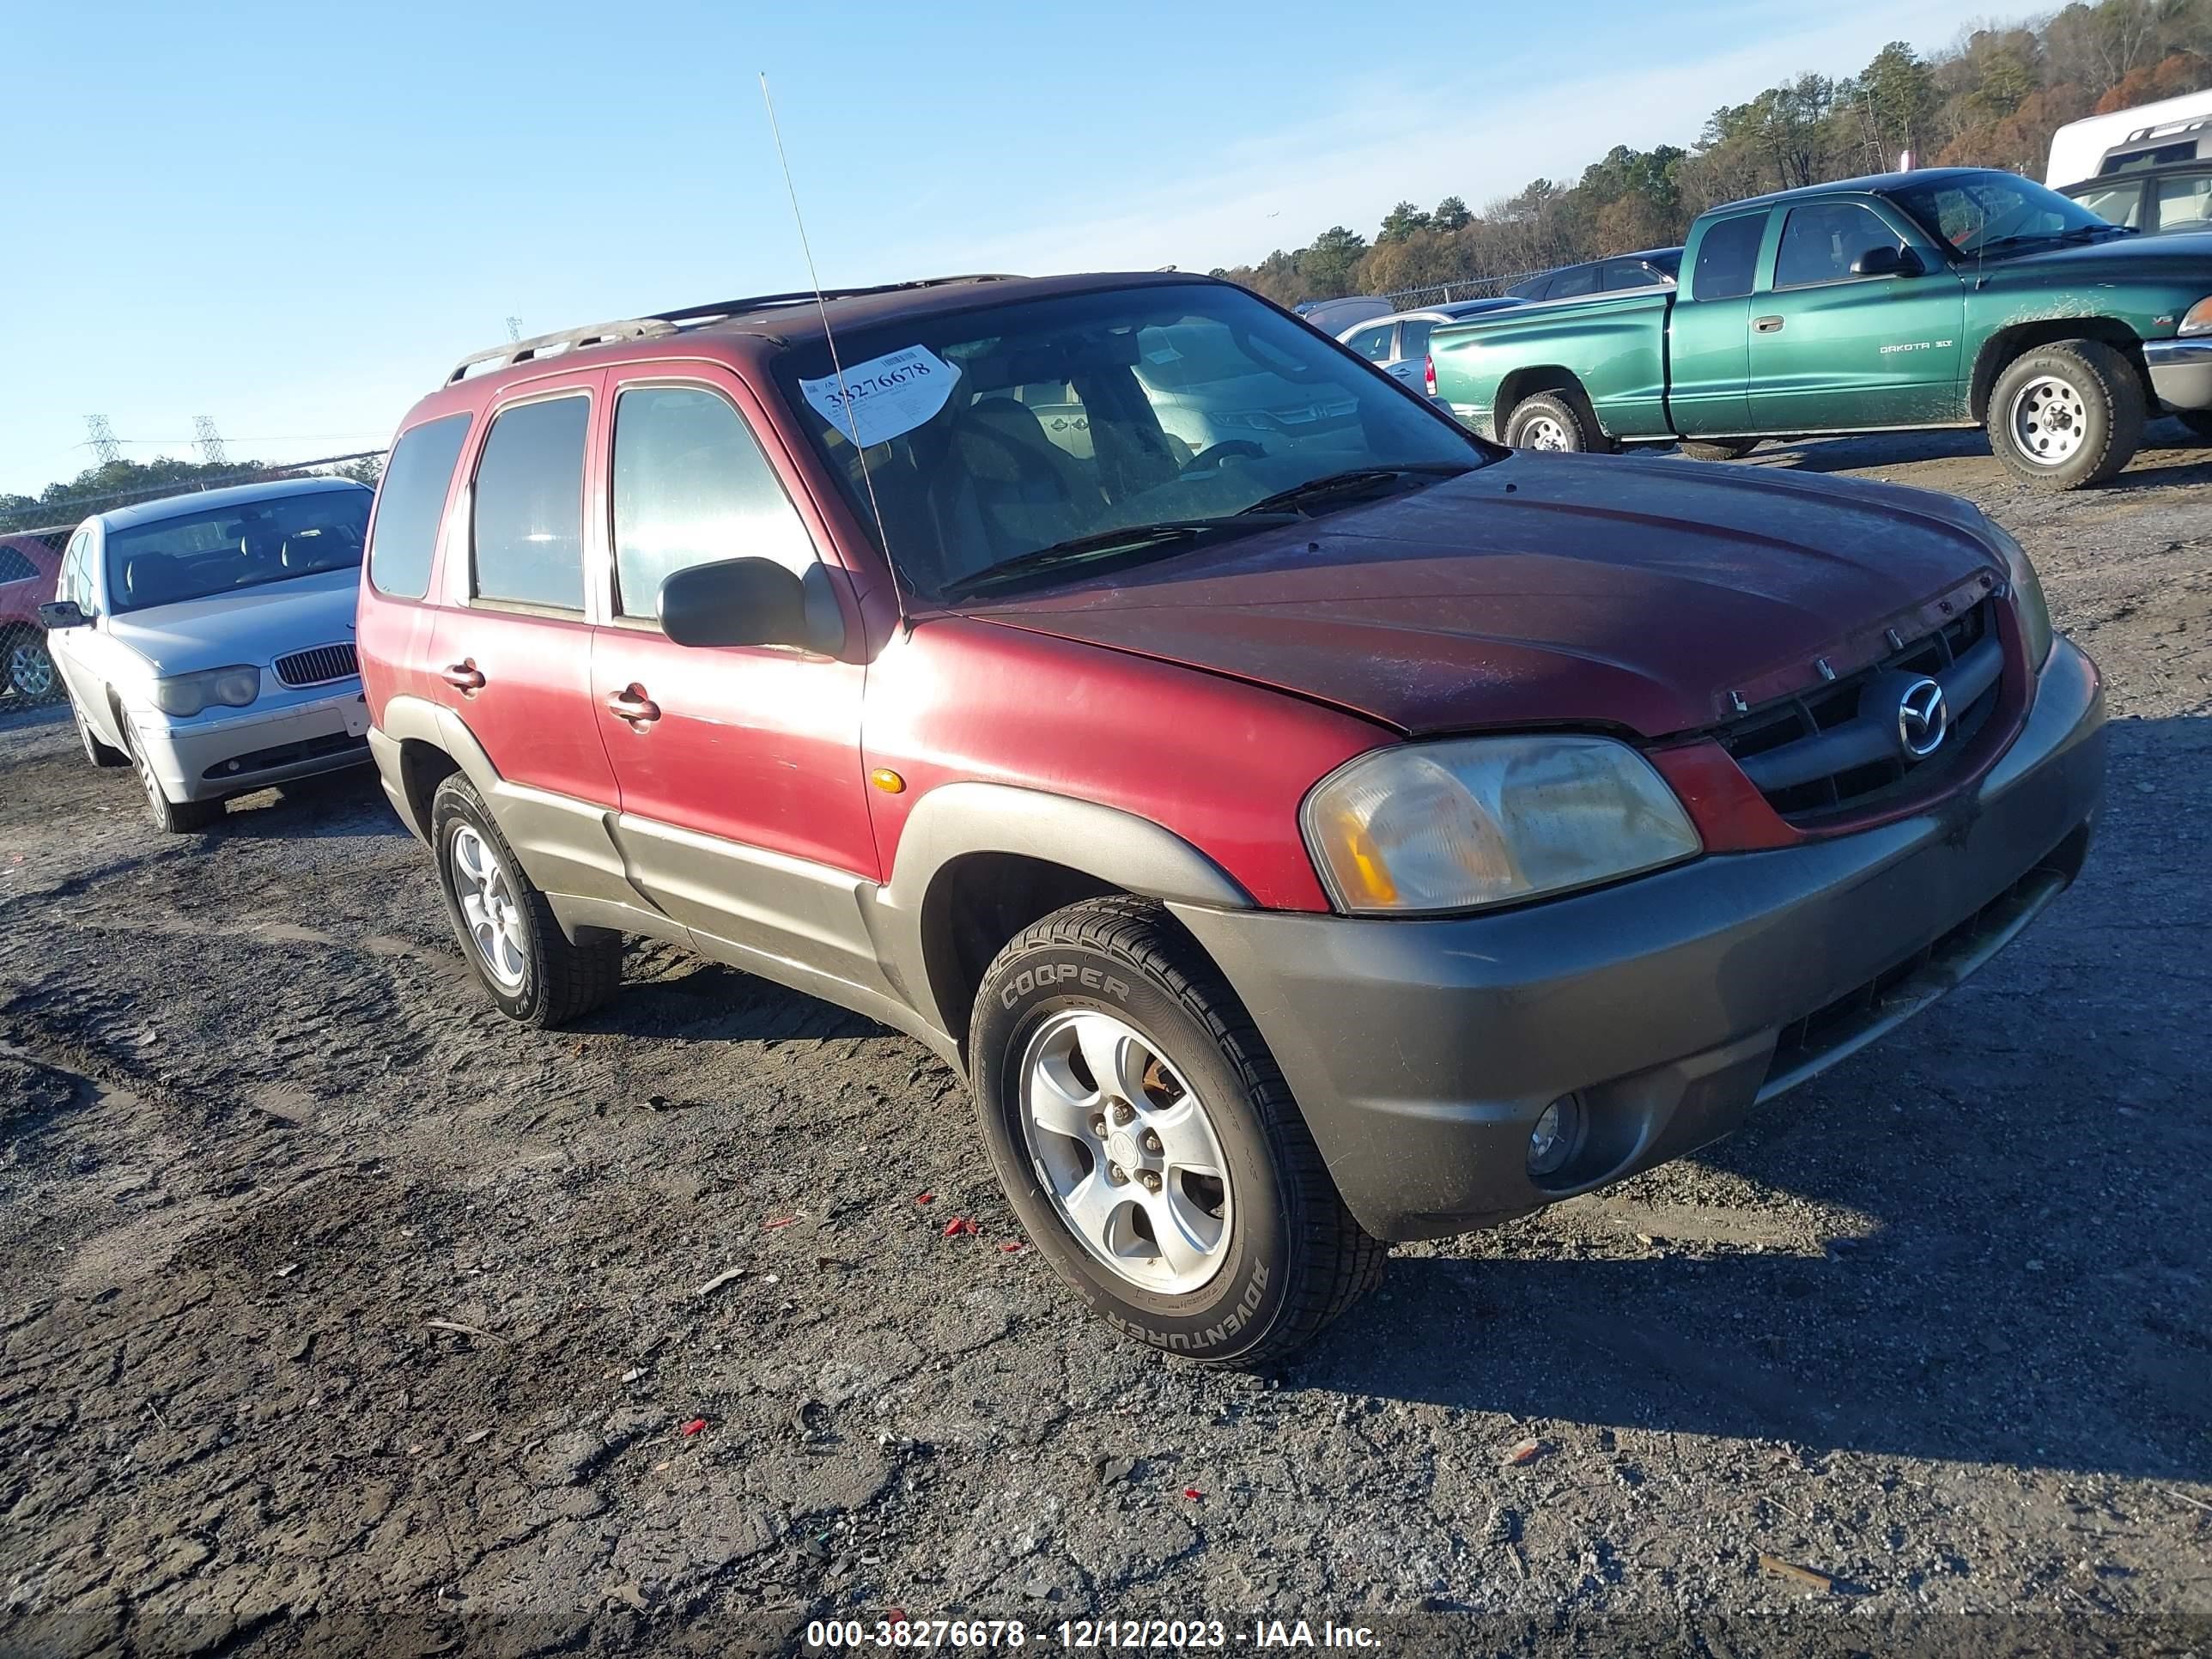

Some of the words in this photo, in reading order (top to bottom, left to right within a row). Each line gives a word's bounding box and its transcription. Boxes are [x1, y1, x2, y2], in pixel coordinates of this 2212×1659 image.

[1879, 342, 1930, 354] DAKOTA
[824, 362, 931, 409] 38276678
[1000, 963, 1131, 1011] COOPER
[1106, 1256, 1271, 1351] ADVENTURER
